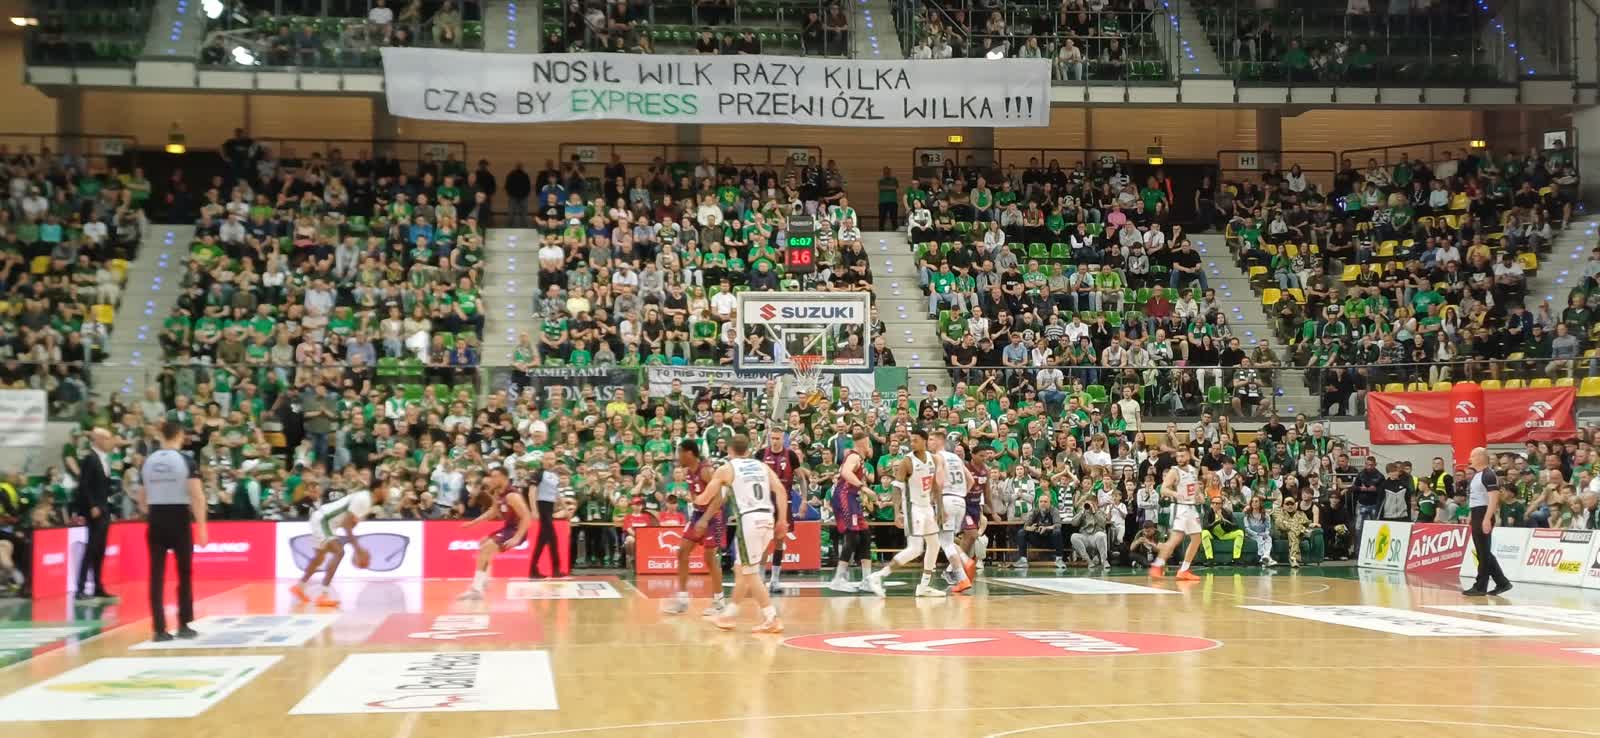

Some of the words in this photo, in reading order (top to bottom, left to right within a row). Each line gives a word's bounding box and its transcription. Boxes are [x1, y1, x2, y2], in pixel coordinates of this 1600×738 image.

[533, 60, 621, 83] NOSIŁ
[638, 62, 713, 85] WILK
[733, 63, 805, 86] RAZY
[824, 67, 911, 90] KILKA
[423, 88, 497, 115] CZAS
[516, 91, 552, 115] BY
[570, 89, 698, 116] EXPRESS
[718, 91, 885, 119] PRZEWIÓZŁ
[903, 96, 993, 119] WILKA
[1004, 96, 1034, 119] !!!
[790, 237, 812, 246] 6:07
[791, 250, 811, 265] 16
[781, 306, 854, 319] SUZUKI
[1454, 416, 1478, 424] ORLEN
[1524, 419, 1556, 429] ORLEN
[1387, 423, 1416, 431] ORLEN
[752, 483, 764, 501] 0
[1526, 548, 1563, 567] BRICO
[647, 560, 673, 569] Bank
